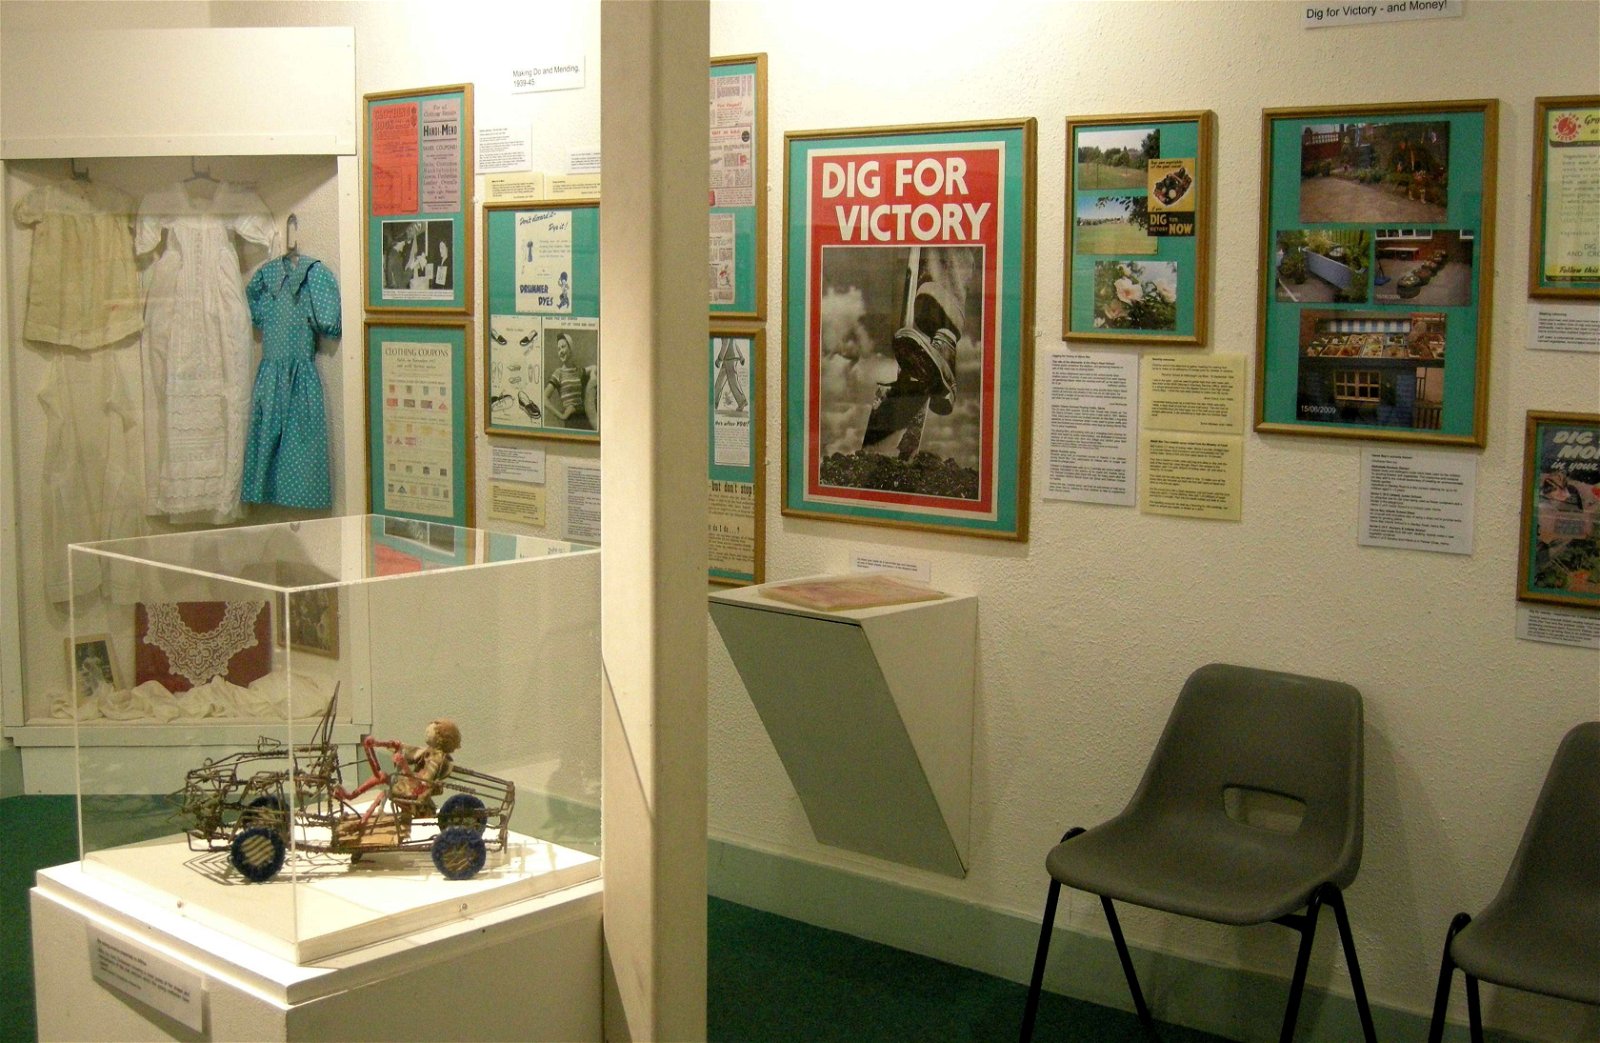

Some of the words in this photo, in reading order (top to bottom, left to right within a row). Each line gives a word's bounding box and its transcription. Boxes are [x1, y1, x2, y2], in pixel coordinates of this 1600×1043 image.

[1306, 8, 1323, 20] Dig
[1326, 8, 1340, 16] for
[1342, 6, 1377, 17] Victory
[1386, 2, 1406, 13] and
[1410, 0, 1447, 12] Money!
[821, 160, 881, 199] DIG
[895, 157, 969, 197] FOR
[835, 202, 991, 242] VICTORY
[1150, 214, 1167, 225] DIG
[1169, 223, 1193, 235] NOW
[1584, 265, 1599, 274] this
[538, 296, 554, 306] DYES
[418, 348, 449, 357] COUPONS
[1553, 431, 1593, 445] DIG
